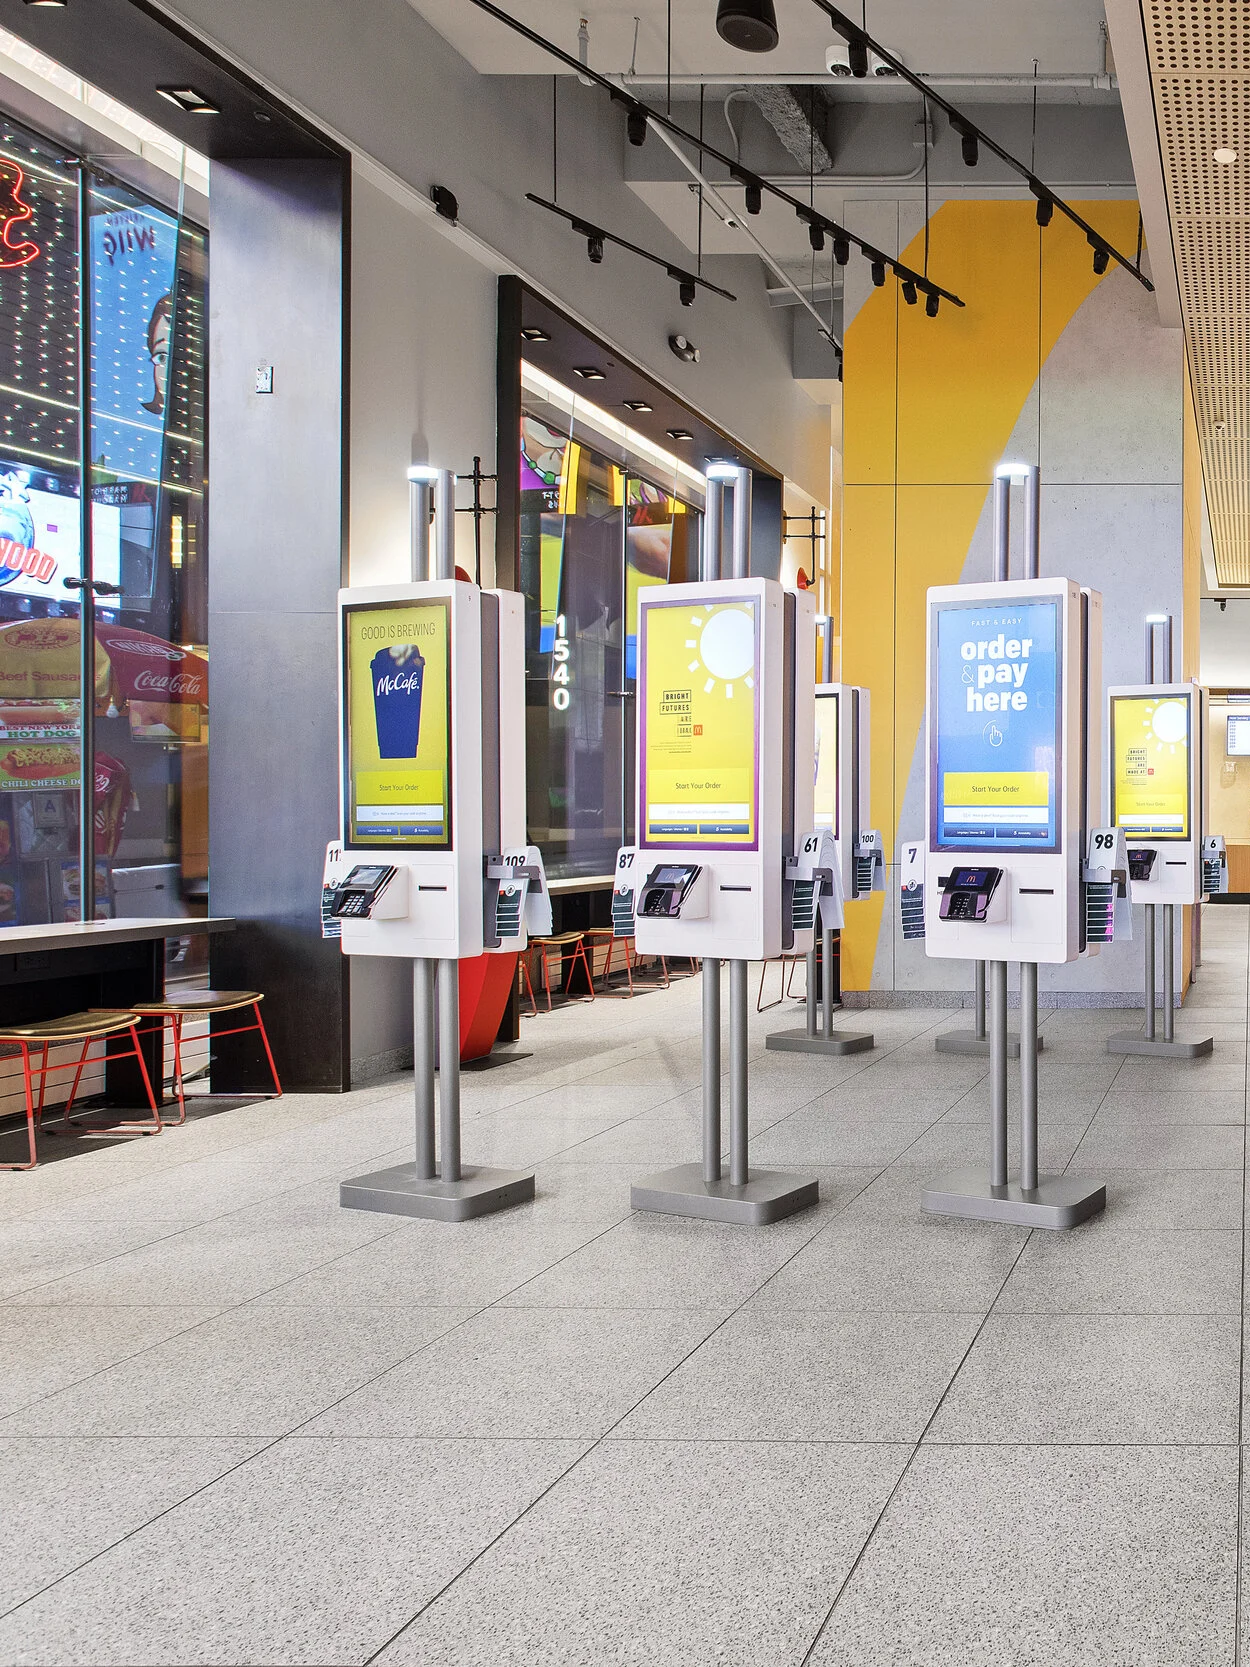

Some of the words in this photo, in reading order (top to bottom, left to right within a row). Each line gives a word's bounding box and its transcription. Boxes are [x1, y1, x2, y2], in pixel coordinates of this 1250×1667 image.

[361, 626, 385, 640] GOOD
[388, 625, 395, 638] IS
[397, 622, 436, 637] BREWING
[960, 633, 1033, 661] order
[961, 664, 975, 684] &
[977, 663, 1029, 689] pay
[966, 686, 1028, 713] here
[662, 704, 690, 712] FUTURES
[1, 780, 29, 788] CHILI
[31, 779, 68, 787] CHEESE
[404, 783, 419, 791] Order
[1002, 785, 1020, 793] Order
[804, 837, 819, 853] 61
[861, 834, 874, 843] 100
[1094, 834, 1114, 850] 98
[1210, 839, 1217, 849] 6
[329, 849, 341, 862] 11
[505, 855, 526, 867] 109
[619, 853, 635, 869] 87
[908, 848, 918, 864] 7
